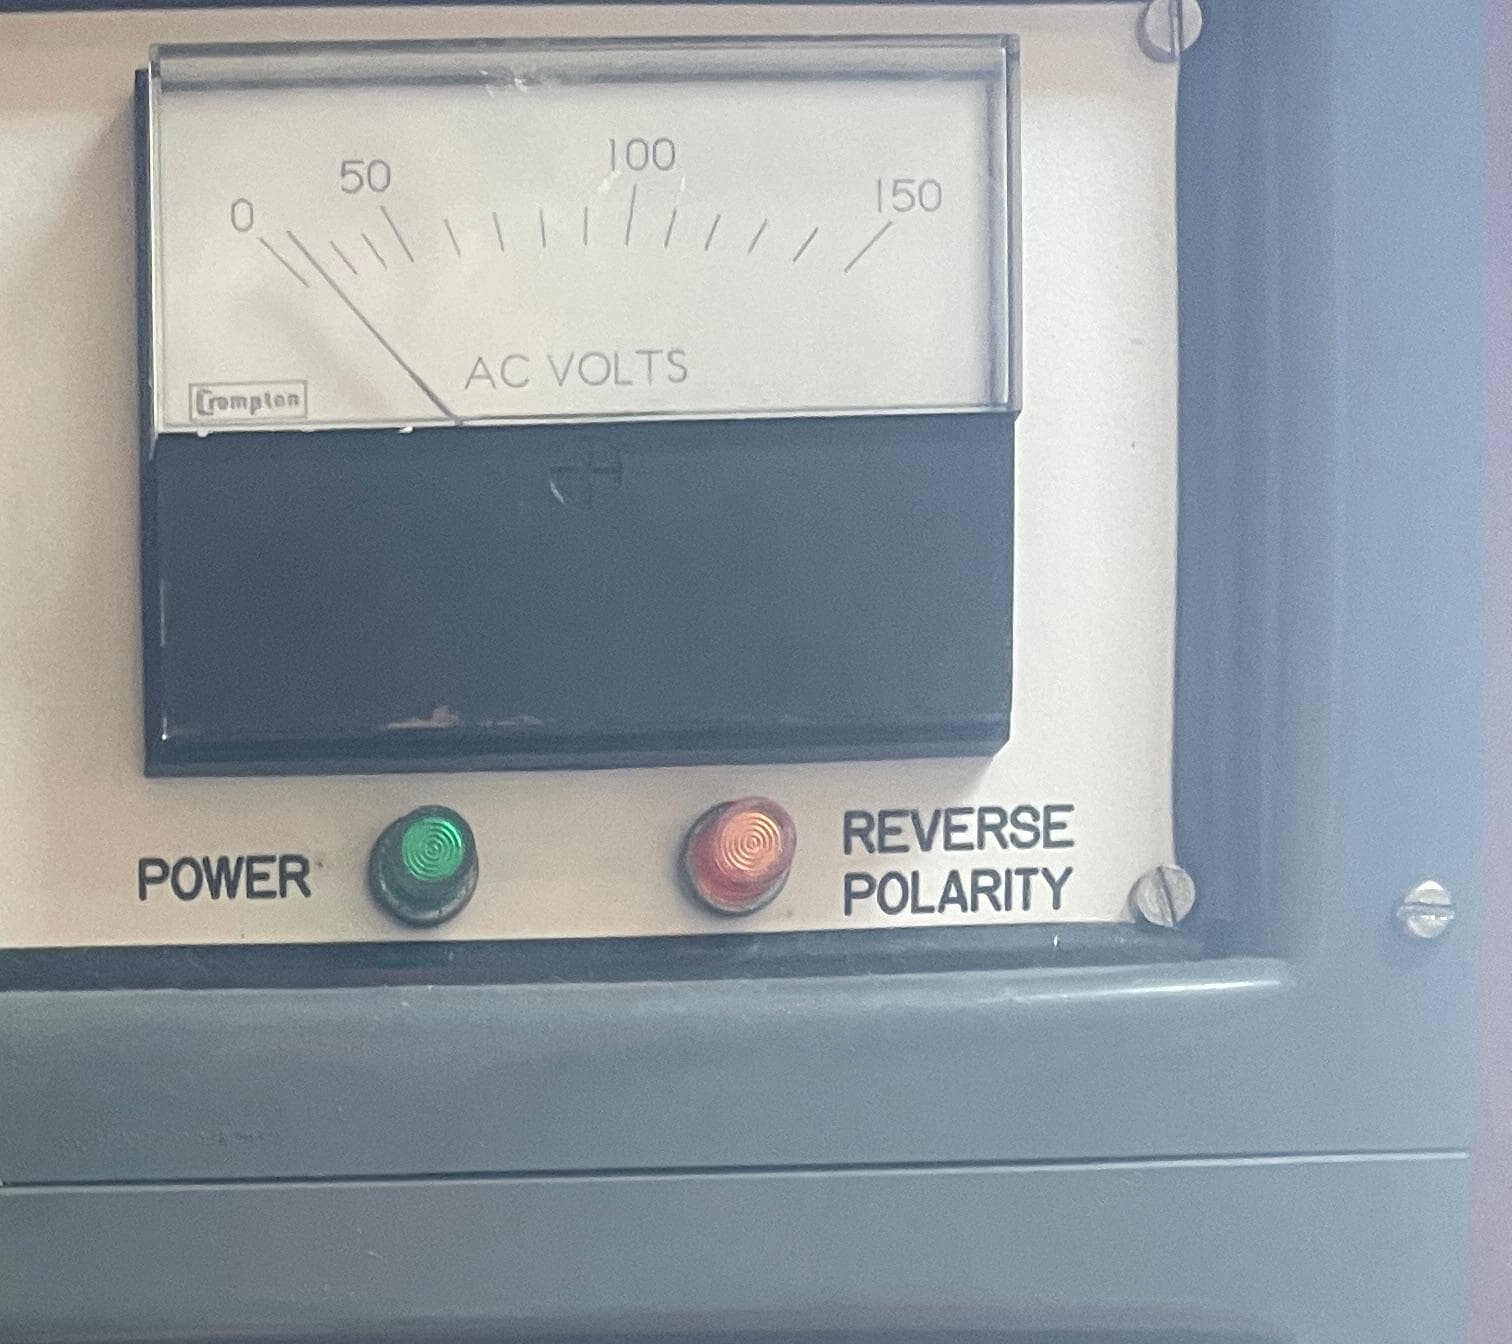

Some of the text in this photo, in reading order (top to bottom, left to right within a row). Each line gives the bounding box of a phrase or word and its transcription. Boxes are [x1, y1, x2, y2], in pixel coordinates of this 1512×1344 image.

[231, 137, 942, 232] 0 50 100 150
[465, 350, 687, 390] AC VOLTS
[195, 388, 300, 415] Crompton
[842, 803, 1075, 857] REVERSE
[137, 854, 312, 902] POWER
[842, 866, 1075, 918] POLARITY
